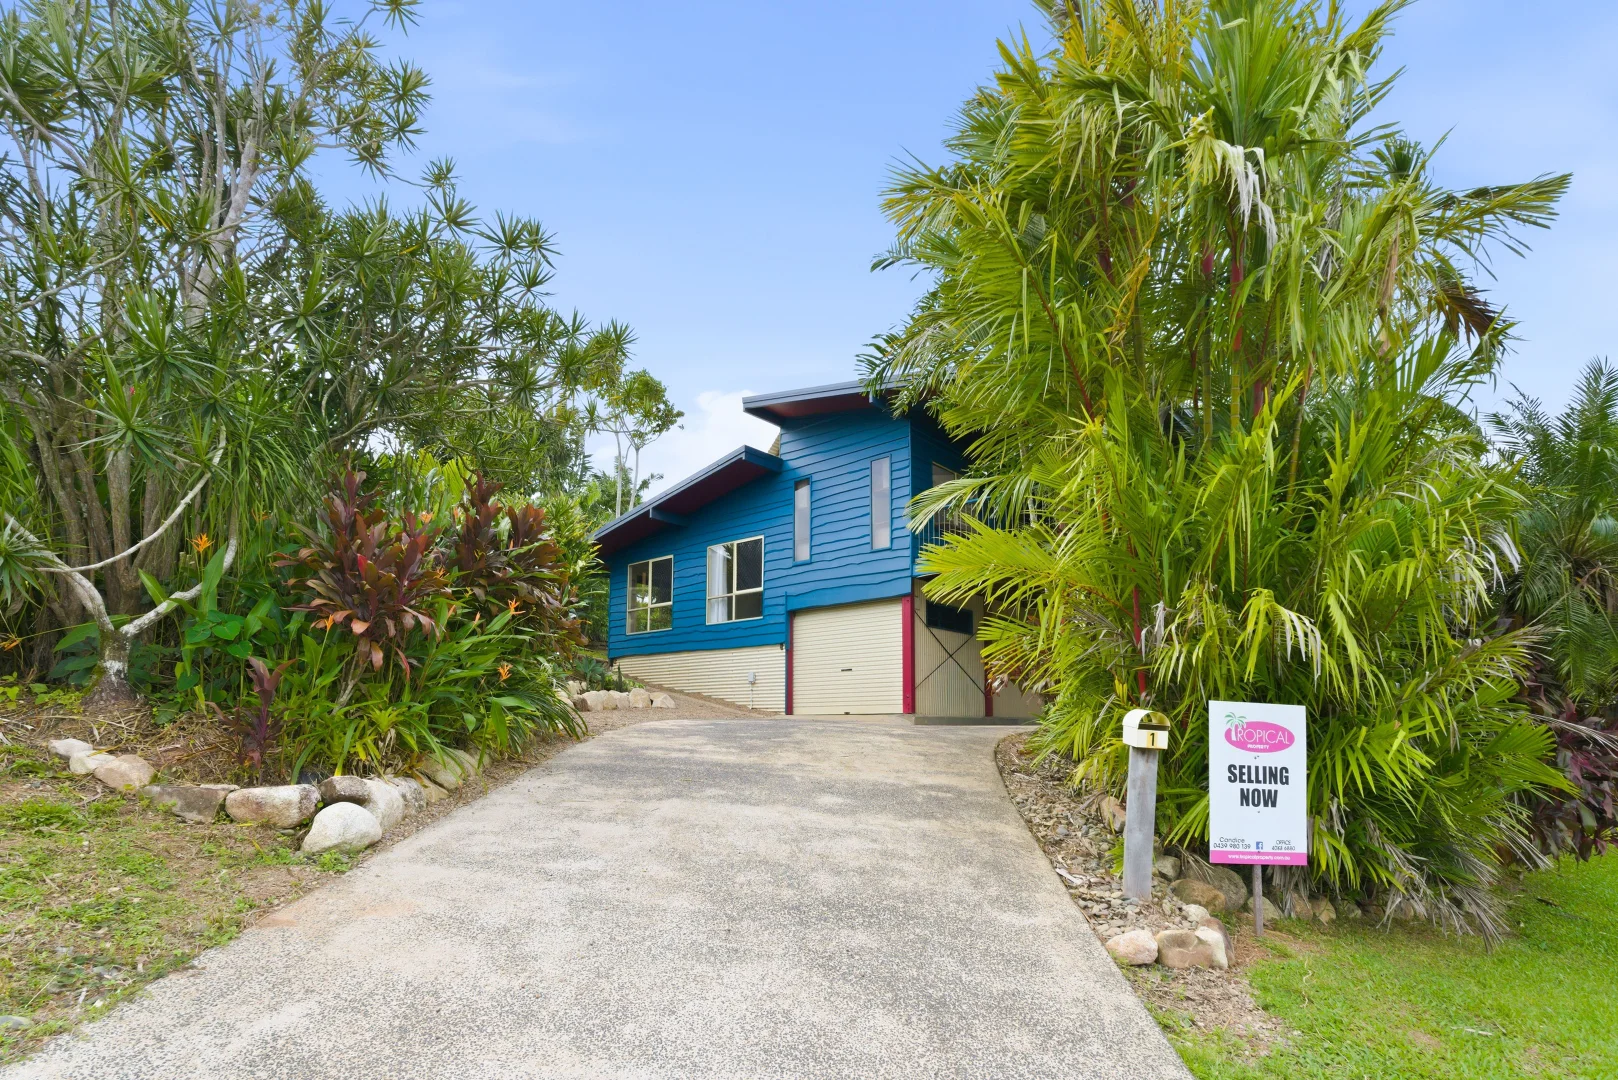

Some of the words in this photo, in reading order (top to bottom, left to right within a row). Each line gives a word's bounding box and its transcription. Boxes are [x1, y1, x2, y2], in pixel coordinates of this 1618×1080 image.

[1149, 732, 1155, 747] 1
[1226, 719, 1290, 745] TROPICAL
[1227, 763, 1290, 786] SELLING
[1239, 788, 1279, 808] NOW
[1219, 836, 1246, 844] Candice
